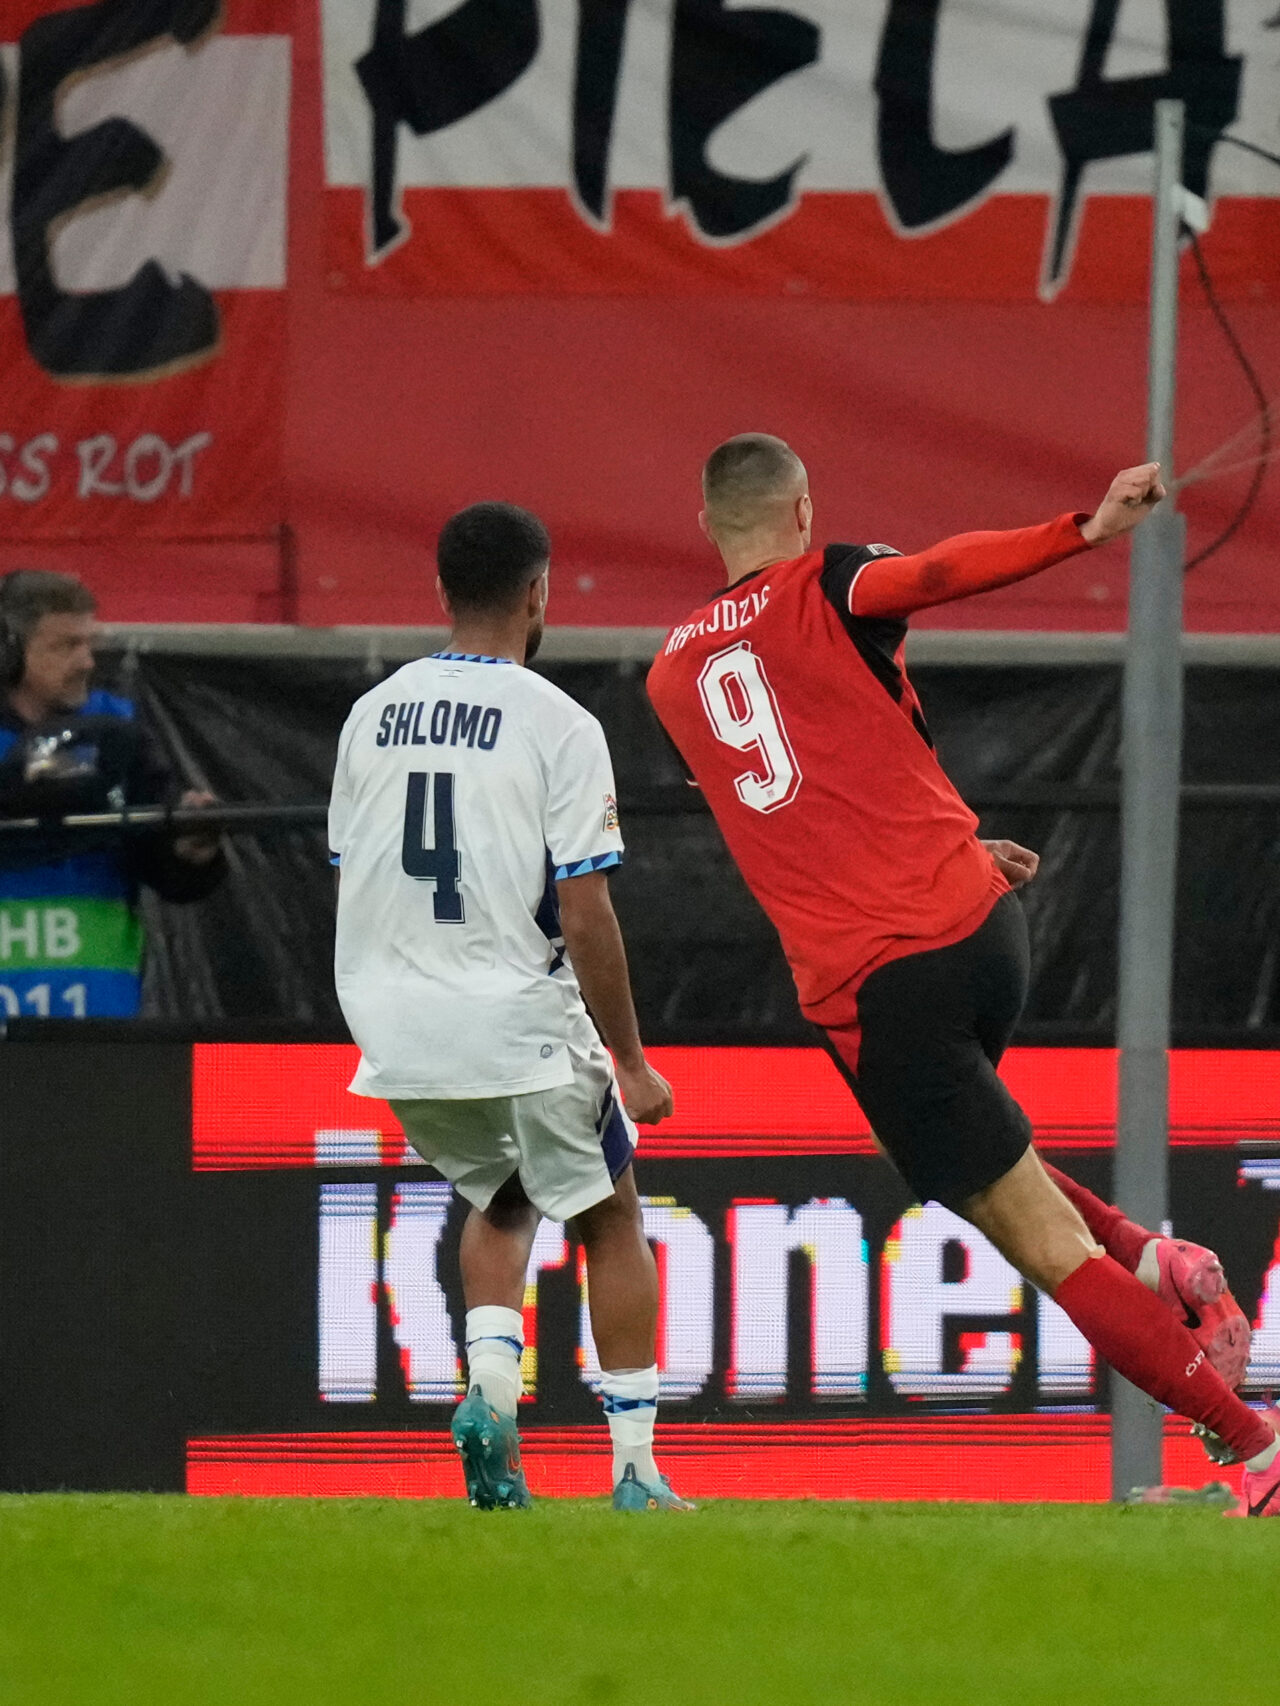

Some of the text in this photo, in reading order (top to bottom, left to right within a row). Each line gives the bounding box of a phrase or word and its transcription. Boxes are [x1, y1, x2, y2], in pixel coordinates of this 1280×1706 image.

[76, 432, 213, 500] ROT
[375, 699, 503, 751] SHLOMO
[697, 640, 803, 815] 9
[401, 771, 466, 924] 4
